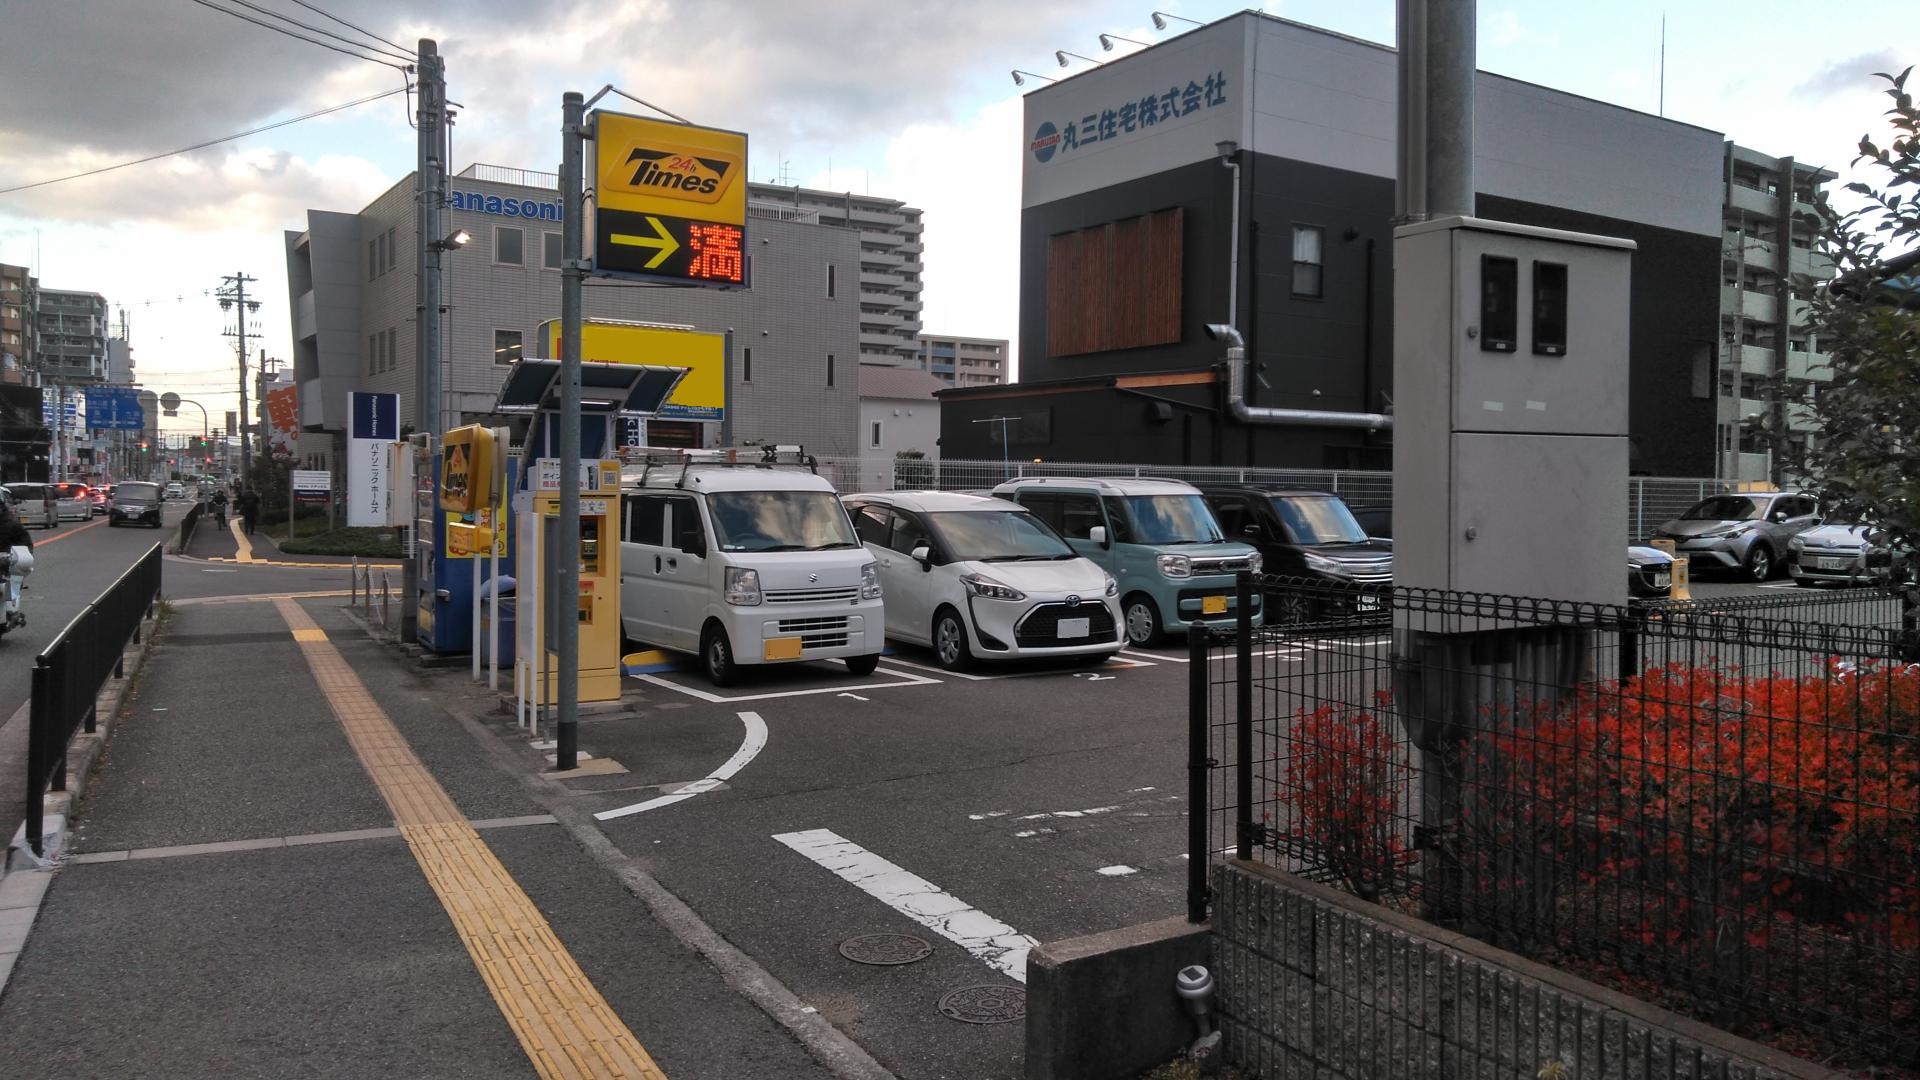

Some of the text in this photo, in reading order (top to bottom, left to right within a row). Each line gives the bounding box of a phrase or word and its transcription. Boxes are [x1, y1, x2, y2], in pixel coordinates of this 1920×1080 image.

[1062, 71, 1226, 153] 丸三住宅株式会社
[624, 148, 719, 194] Times
[451, 190, 564, 222] anasoni
[689, 225, 742, 281] 満
[1073, 672, 1116, 681] 2
